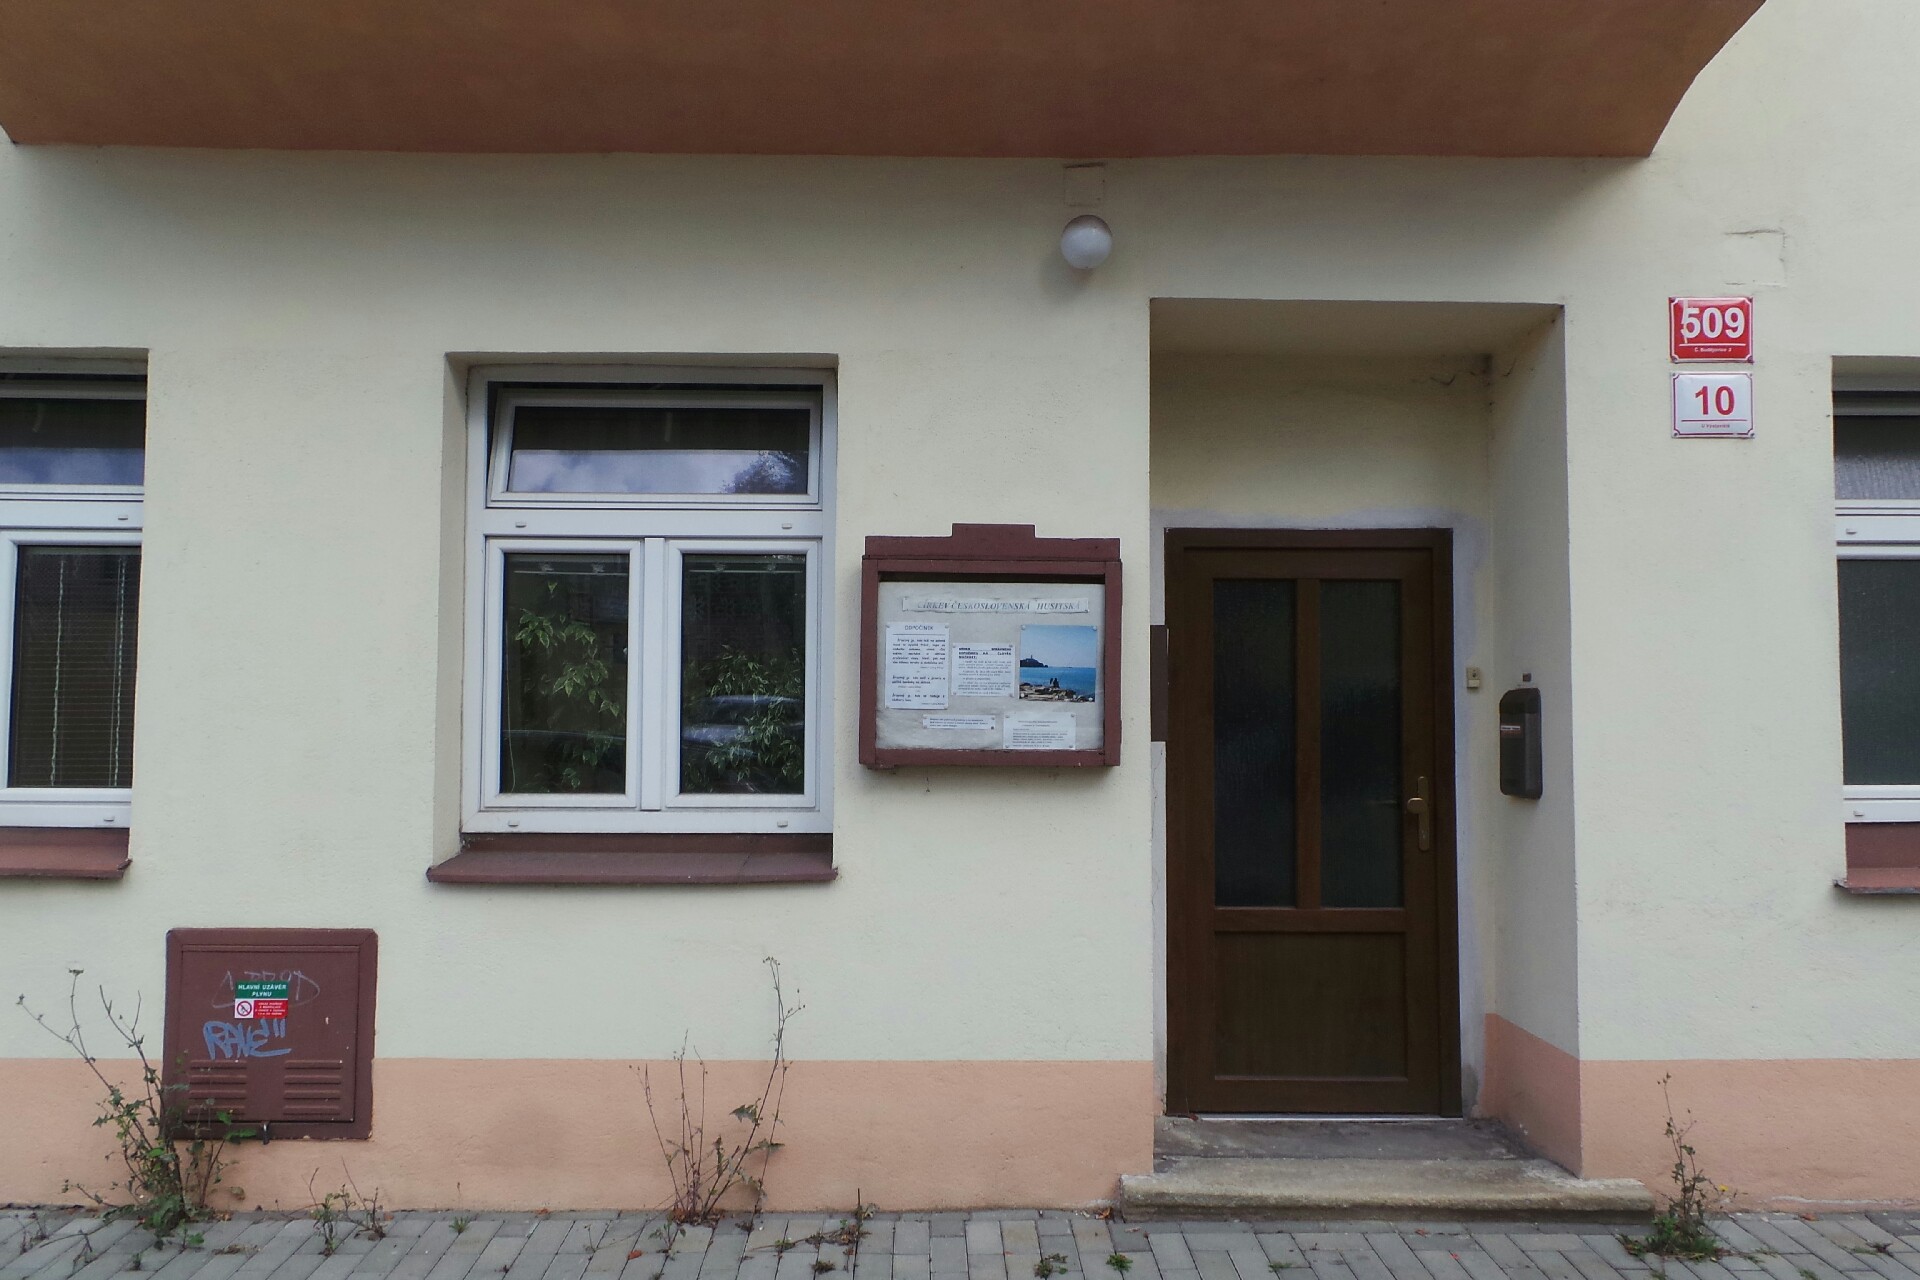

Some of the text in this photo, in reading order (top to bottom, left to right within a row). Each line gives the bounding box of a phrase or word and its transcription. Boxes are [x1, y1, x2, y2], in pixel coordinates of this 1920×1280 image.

[1681, 307, 1745, 339] 509
[1695, 385, 1735, 416] 10
[951, 599, 1031, 610] ČESKOSLOVENSKÁ
